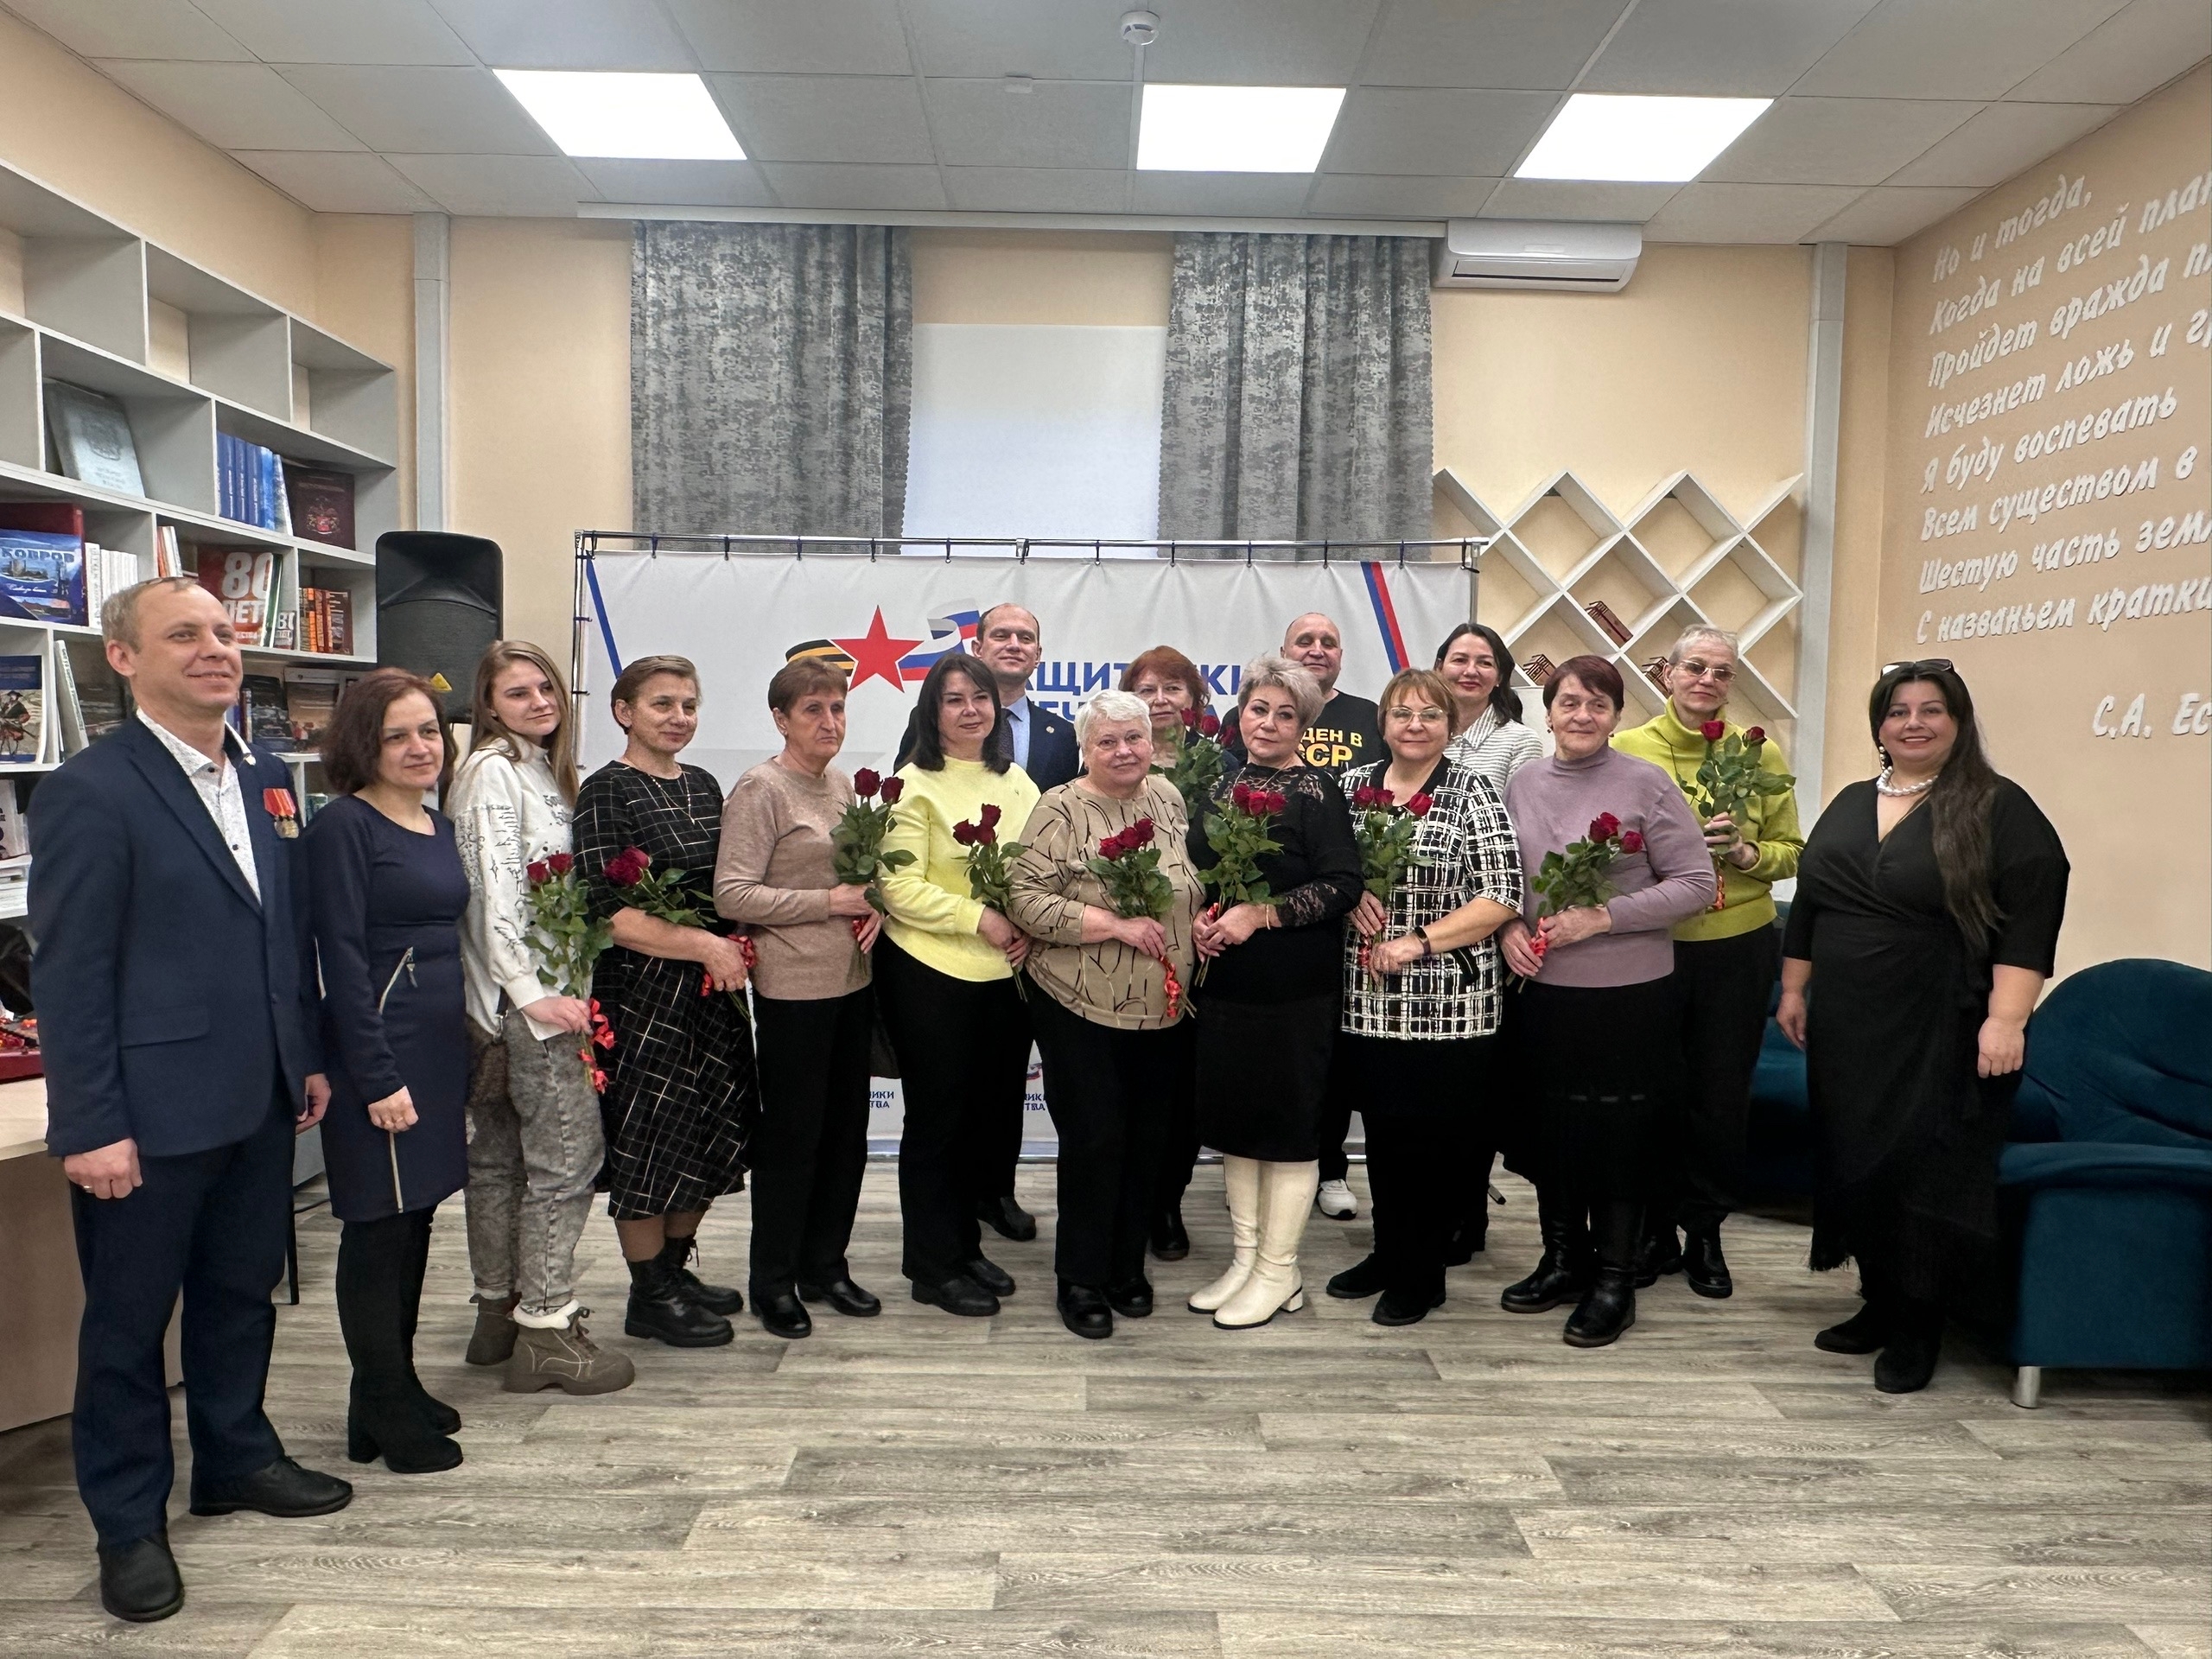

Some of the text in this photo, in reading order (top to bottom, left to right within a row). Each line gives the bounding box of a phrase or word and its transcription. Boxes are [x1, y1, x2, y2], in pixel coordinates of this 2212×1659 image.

[1929, 275, 2001, 335] Когда
[2011, 256, 2045, 297] на
[2056, 202, 2129, 273] всей
[1933, 174, 2092, 283] Но и тогда,
[1928, 322, 2037, 390] Пройдет
[2050, 254, 2170, 340] вражда
[1924, 373, 2046, 438] Исчезнет
[2055, 339, 2134, 393] ложь
[2150, 323, 2172, 358] и
[1920, 386, 2177, 494] Я буду воспевать
[1921, 445, 2198, 542] Всем существом в
[1919, 549, 2018, 594] Шестую
[2031, 527, 2120, 573] часть
[1916, 610, 1933, 645] С
[1936, 598, 2076, 643] названьем
[1350, 732, 1363, 747] В
